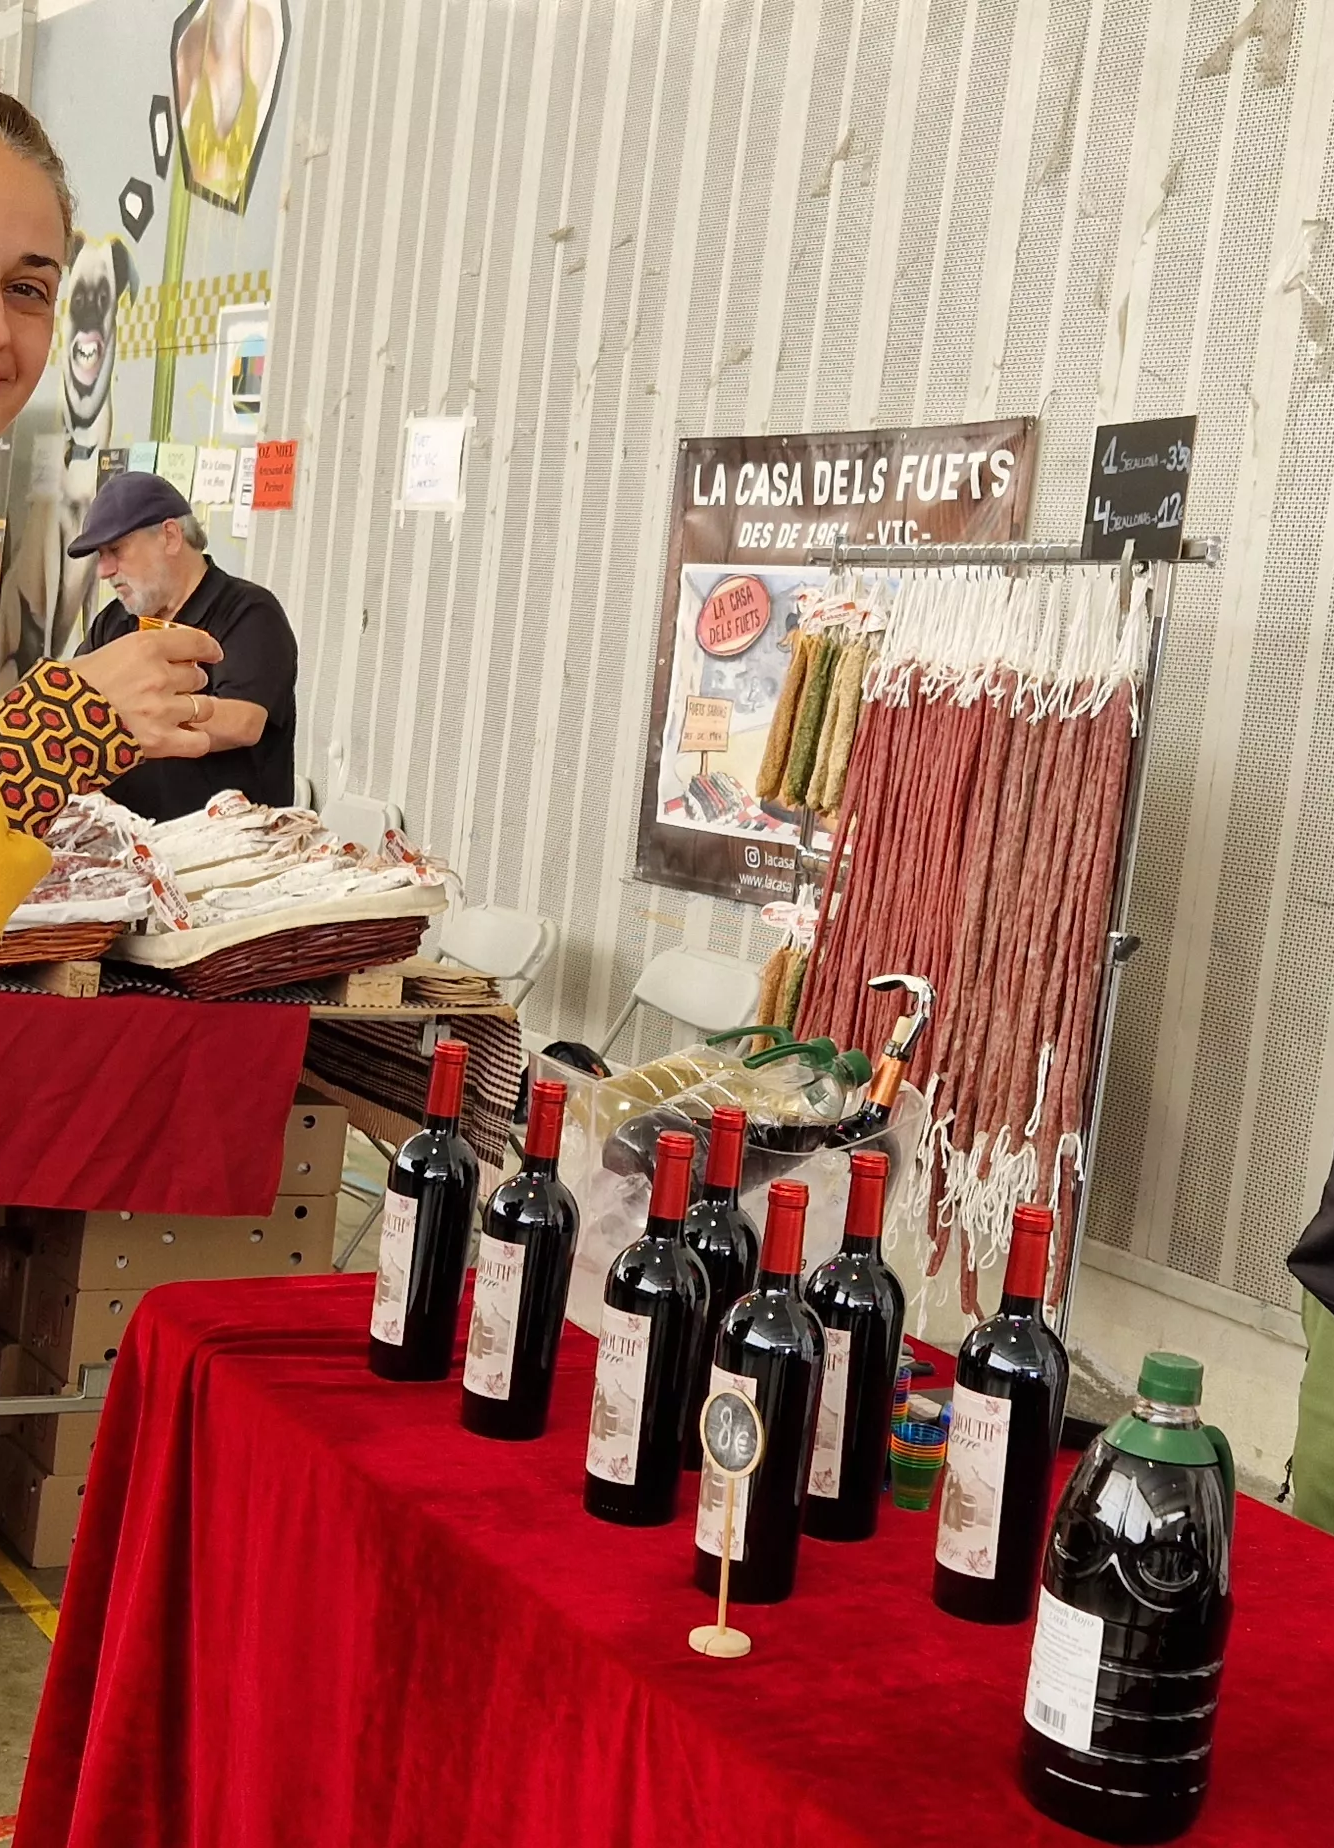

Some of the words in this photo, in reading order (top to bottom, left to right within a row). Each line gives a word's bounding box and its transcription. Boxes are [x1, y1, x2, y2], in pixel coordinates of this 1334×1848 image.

[1101, 435, 1118, 474] 1
[693, 464, 727, 506] LA
[735, 462, 805, 507] CASA
[813, 457, 888, 506] DELS
[896, 449, 1016, 502] FUETS
[1093, 496, 1111, 535] 4
[738, 522, 774, 549] DES
[775, 522, 802, 549] DE
[712, 598, 726, 620] LA
[729, 585, 755, 612] CASA
[709, 620, 732, 645] DELS
[735, 608, 761, 636] FUETS
[718, 1405, 750, 1457] 8€
